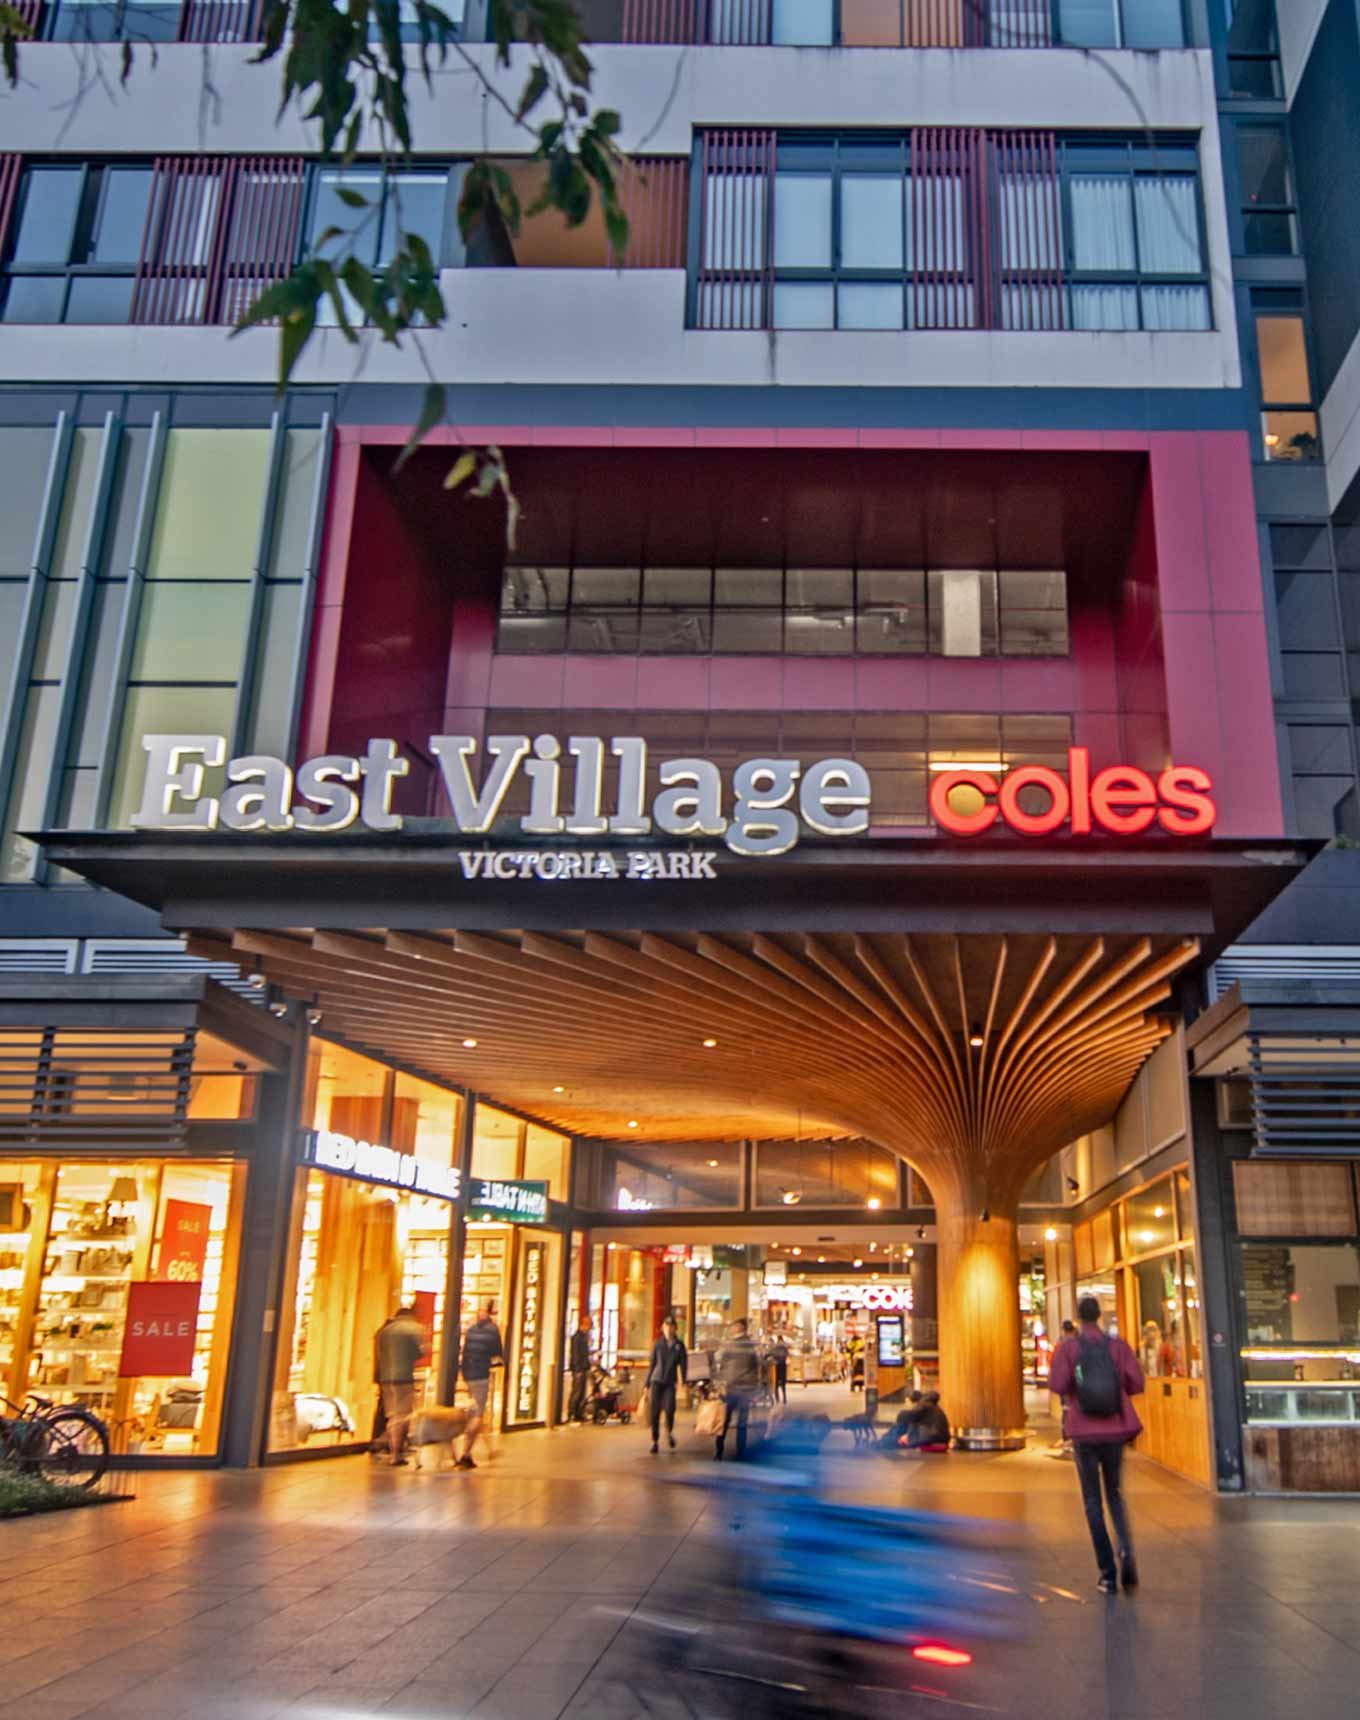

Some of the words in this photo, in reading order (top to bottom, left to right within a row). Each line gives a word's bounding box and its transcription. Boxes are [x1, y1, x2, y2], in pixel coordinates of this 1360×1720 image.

[129, 733, 409, 832] East
[429, 733, 871, 856] Village
[928, 746, 1217, 836] coles
[458, 850, 619, 880] VICTORIA
[626, 850, 718, 880] PARK
[176, 1219, 200, 1233] SALE
[167, 1258, 198, 1282] 60%
[131, 1320, 191, 1338] SALE
[519, 1352, 534, 1411] TABLE
